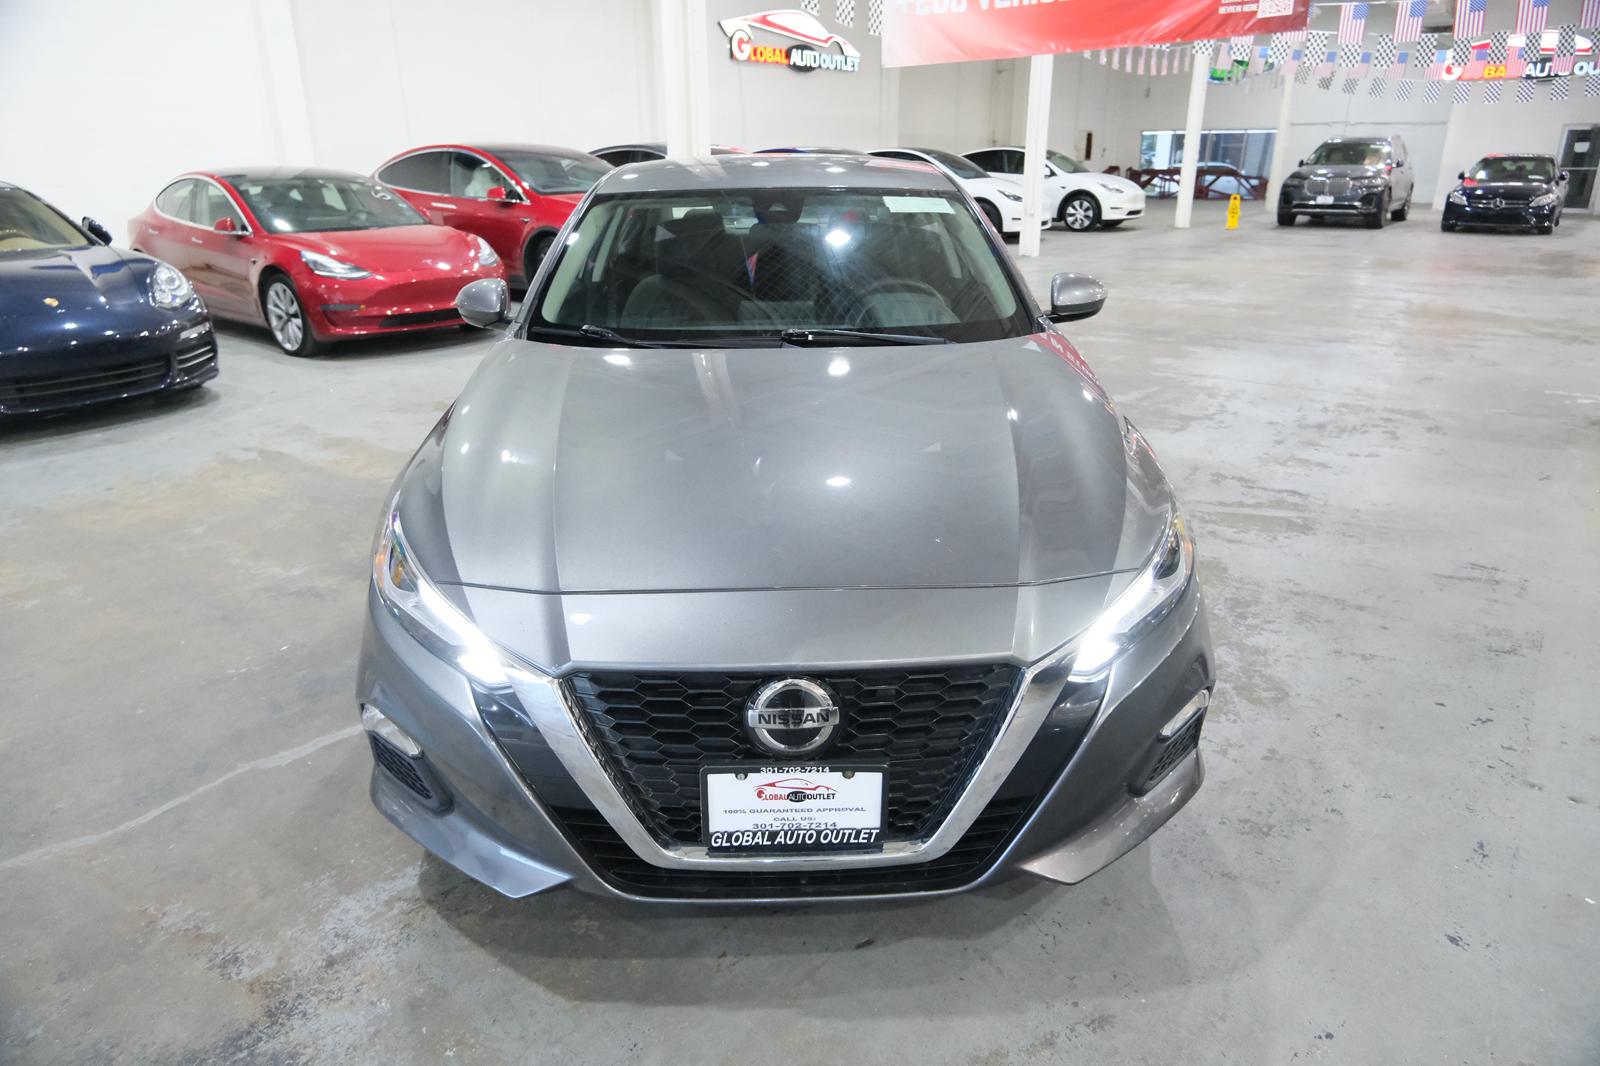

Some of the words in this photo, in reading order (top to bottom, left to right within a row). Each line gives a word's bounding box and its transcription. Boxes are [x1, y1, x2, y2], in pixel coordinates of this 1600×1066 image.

[731, 29, 789, 65] GLOBAL
[790, 48, 820, 67] AUTO
[820, 54, 860, 72] OUTLET
[758, 711, 830, 725] NISSAN
[760, 766, 830, 774] 301-702-7214
[756, 788, 788, 801] GLOBAL
[752, 822, 837, 830] 301-702-7214
[711, 831, 771, 847] GLOBAL
[775, 830, 817, 845] AUTO
[820, 829, 880, 844] OUTLET
